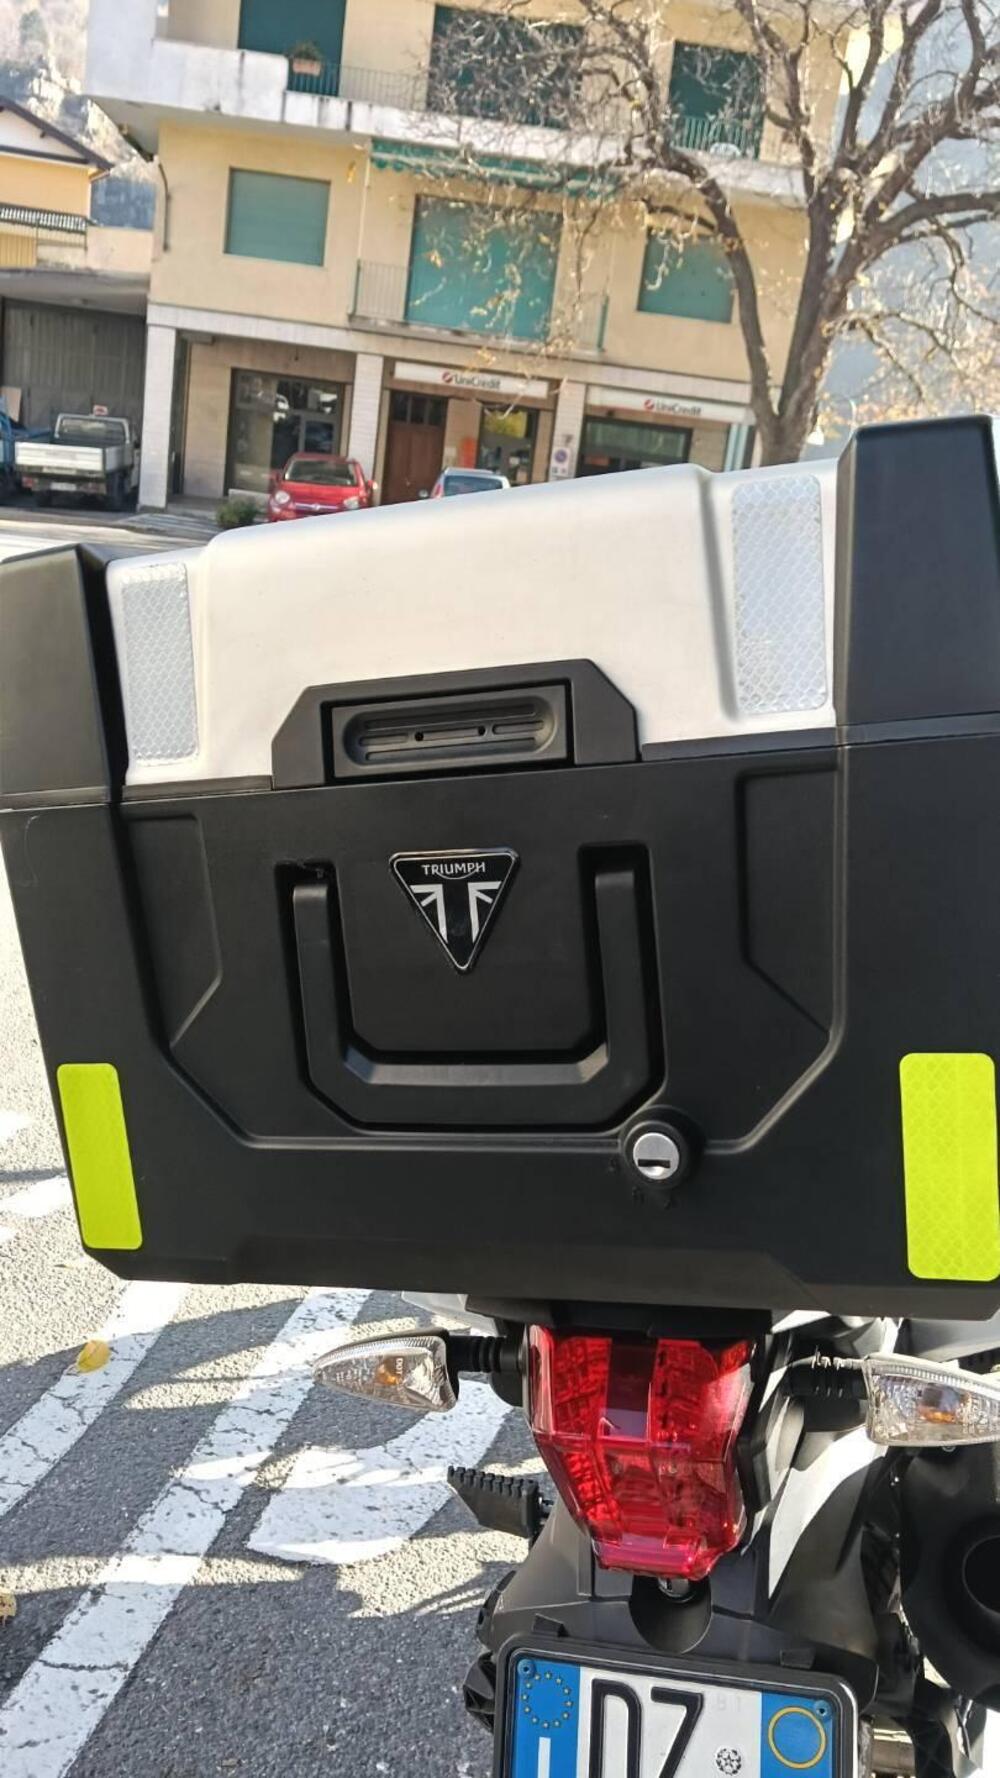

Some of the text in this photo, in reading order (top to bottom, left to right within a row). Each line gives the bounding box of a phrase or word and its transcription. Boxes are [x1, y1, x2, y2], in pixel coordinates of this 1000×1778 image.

[455, 374, 501, 390] UniCredit
[657, 400, 702, 416] UniCredit
[421, 861, 486, 878] TRIUMPH
